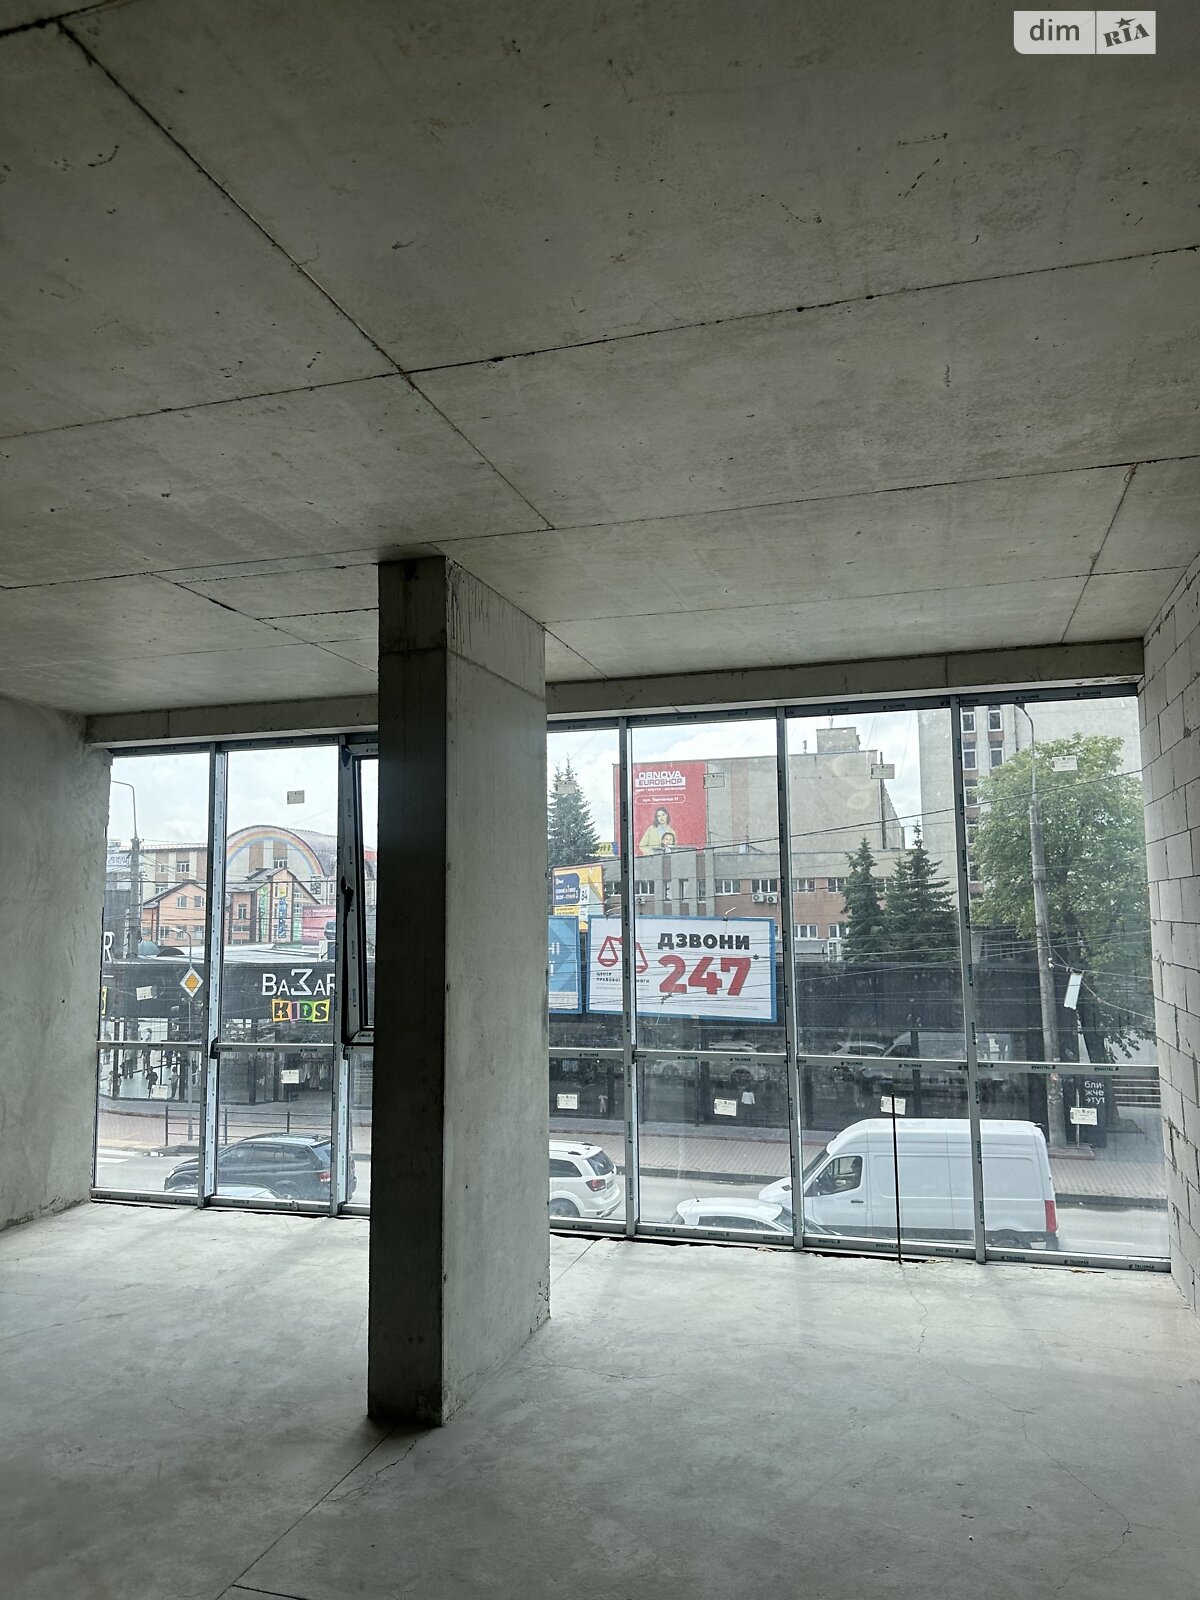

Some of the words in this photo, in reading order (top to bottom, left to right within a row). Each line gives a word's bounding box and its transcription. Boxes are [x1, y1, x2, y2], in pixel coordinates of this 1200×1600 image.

[638, 771, 682, 779] OBNOVA
[638, 778, 683, 786] EUROSHOP
[658, 933, 750, 950] ДЗВОНИ
[658, 954, 752, 997] 247
[272, 1001, 328, 1020] KIDS
